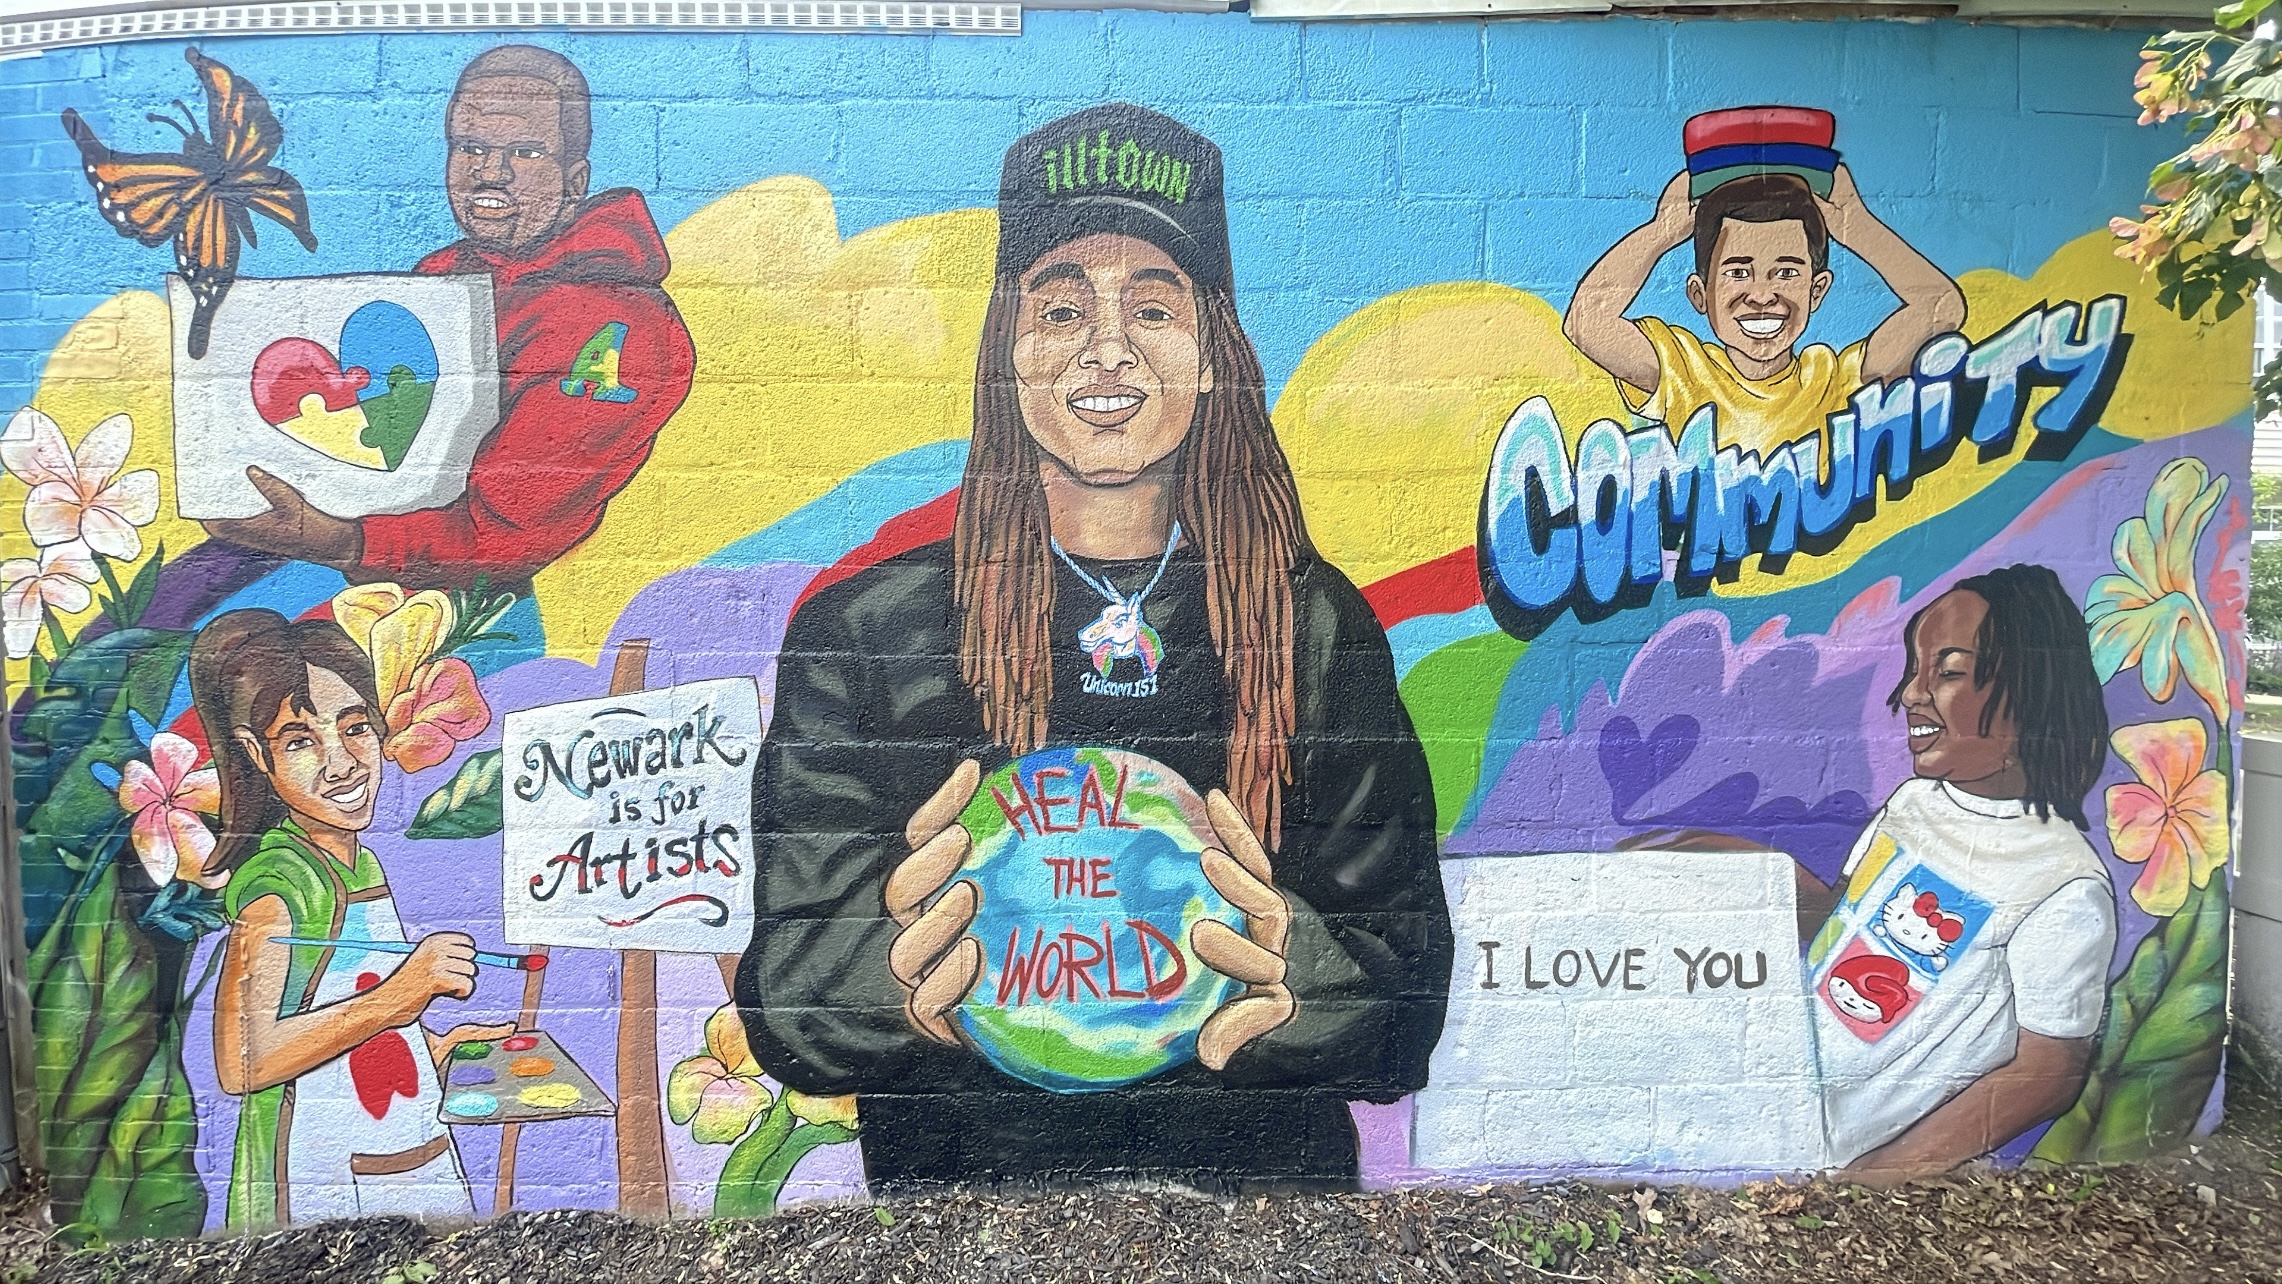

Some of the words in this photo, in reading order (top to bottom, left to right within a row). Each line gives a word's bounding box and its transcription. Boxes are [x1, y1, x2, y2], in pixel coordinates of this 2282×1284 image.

[1042, 128, 1191, 204] illtown
[559, 320, 640, 405] A
[513, 703, 748, 802] Newark
[608, 791, 642, 824] is
[651, 780, 705, 825] for
[990, 763, 1142, 841] HEAL
[529, 818, 741, 901] Artists
[1043, 857, 1120, 900] THE
[996, 919, 1188, 1008] WORLD
[1477, 941, 1501, 990] I
[1524, 946, 1646, 991] LOVE
[1674, 946, 1768, 994] YOU
